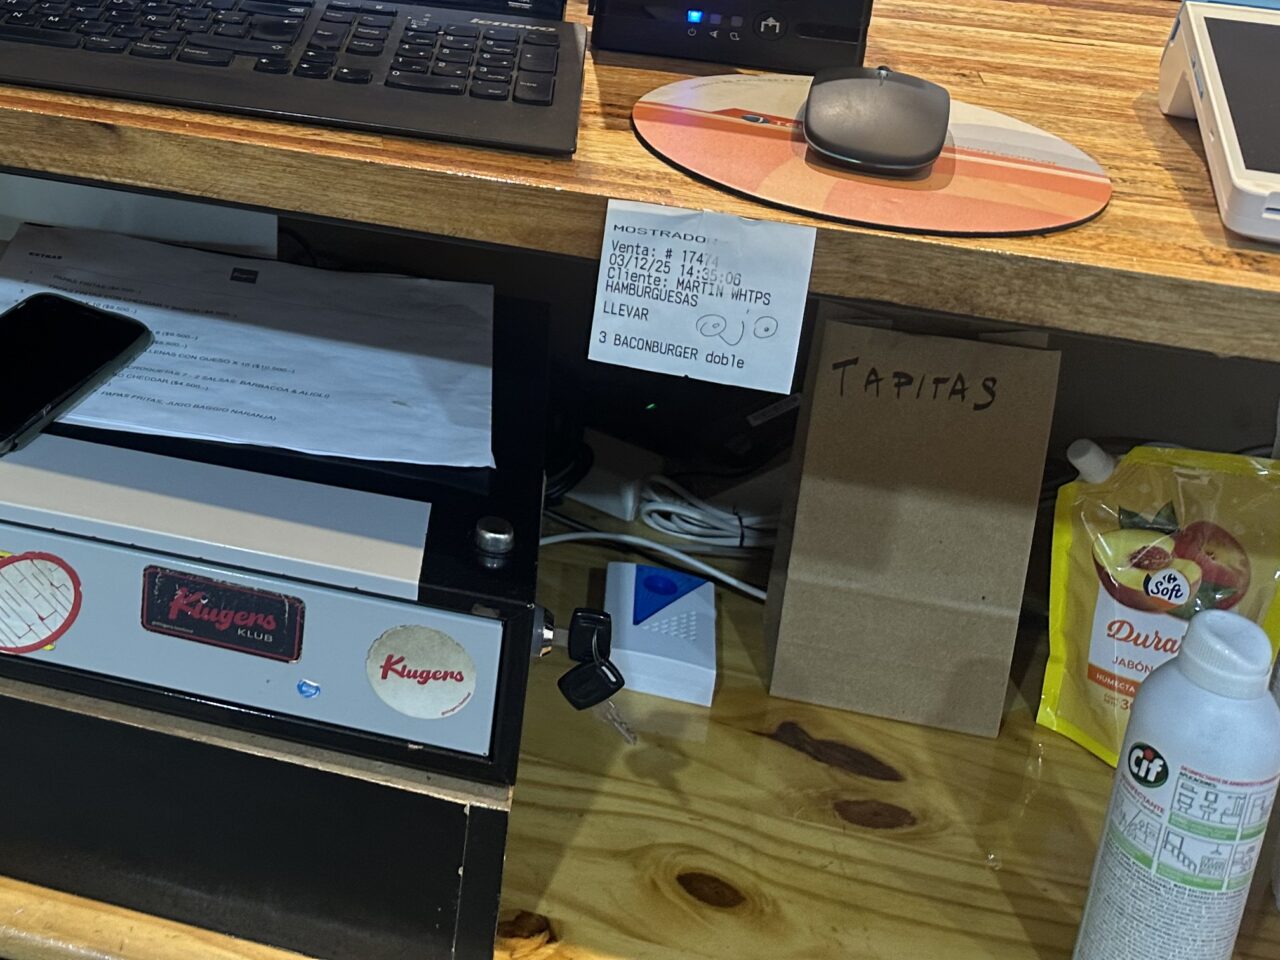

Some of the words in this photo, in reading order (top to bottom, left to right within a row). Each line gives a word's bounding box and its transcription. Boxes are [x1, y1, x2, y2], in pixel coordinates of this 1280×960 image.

[470, 18, 556, 31] lenovo
[611, 240, 656, 258] Venta:
[665, 248, 672, 259] #
[609, 253, 671, 274] 03/12/25
[680, 264, 741, 287] 14:35:06
[605, 280, 699, 307] HAMBURGUESAS
[607, 267, 668, 288] Cliente:
[676, 279, 723, 298] MARTIN
[731, 285, 771, 306] WHTPS
[603, 301, 649, 321] LLEVAR
[599, 331, 607, 344] 3
[613, 333, 699, 361] BACONBURGER
[705, 351, 745, 369] doble
[832, 357, 998, 411] TAPITAS
[1150, 580, 1183, 600] Soft
[169, 586, 277, 630] Klugers
[238, 628, 273, 642] KLUB
[1107, 619, 1182, 654] Dura
[380, 654, 464, 685] Klugers
[1112, 656, 1153, 673] JABÓN
[1130, 747, 1164, 782] Cif
